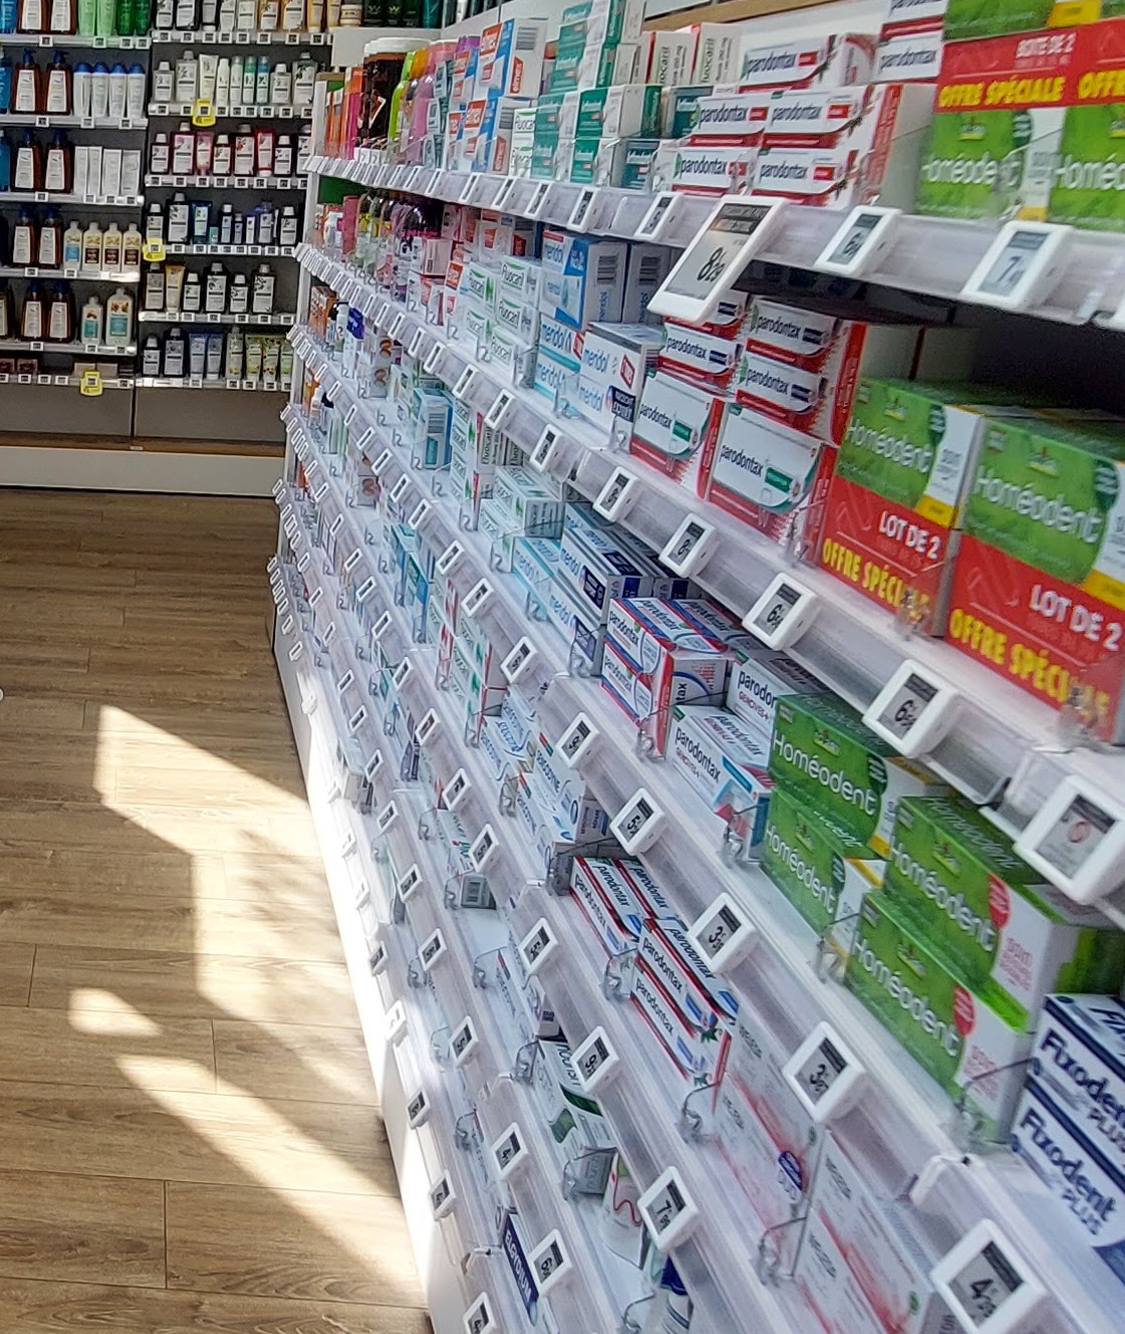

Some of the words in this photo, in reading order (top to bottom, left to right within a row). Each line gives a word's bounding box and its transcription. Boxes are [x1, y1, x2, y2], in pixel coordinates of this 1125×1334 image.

[665, 334, 709, 360] parodontax
[754, 314, 803, 341] parodontax
[745, 365, 789, 394] parodontax
[719, 443, 765, 478] parodontax
[878, 509, 907, 543] LOT
[906, 523, 929, 554] DE
[928, 536, 942, 560] 2
[976, 466, 1103, 545] Homéodent
[822, 538, 862, 583] OFFRE
[948, 607, 1008, 666] OFFRE
[1029, 584, 1072, 621] LOT
[1071, 604, 1104, 641] DE
[1103, 622, 1123, 652] 2
[675, 726, 721, 784] parodontax
[771, 728, 878, 816] Homéodent
[764, 821, 834, 915] Homéodent
[890, 836, 997, 953] Homéodent
[851, 930, 962, 1058] Homéodent
[1040, 1027, 1125, 1130] Fixoden
